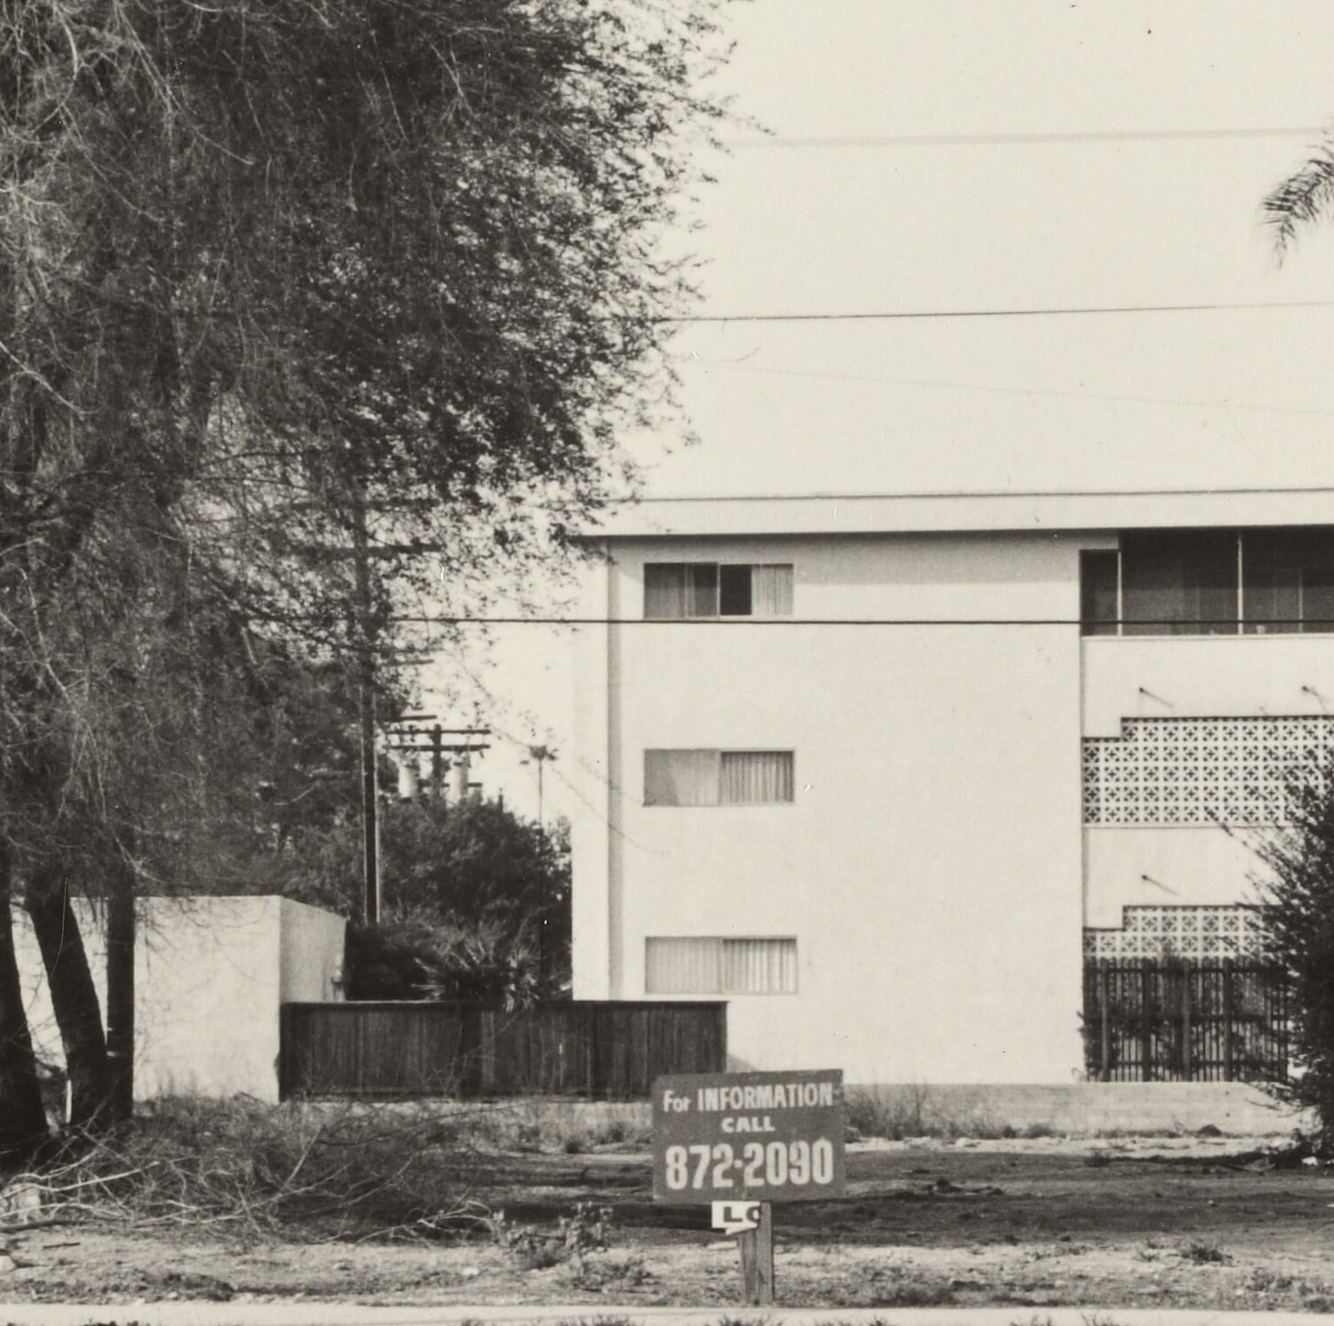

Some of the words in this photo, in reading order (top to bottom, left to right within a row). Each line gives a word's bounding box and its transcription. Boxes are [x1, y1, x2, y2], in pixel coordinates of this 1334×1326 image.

[664, 1089, 692, 1112] For
[698, 1082, 833, 1111] INFORMATION
[721, 1116, 776, 1133] CALL
